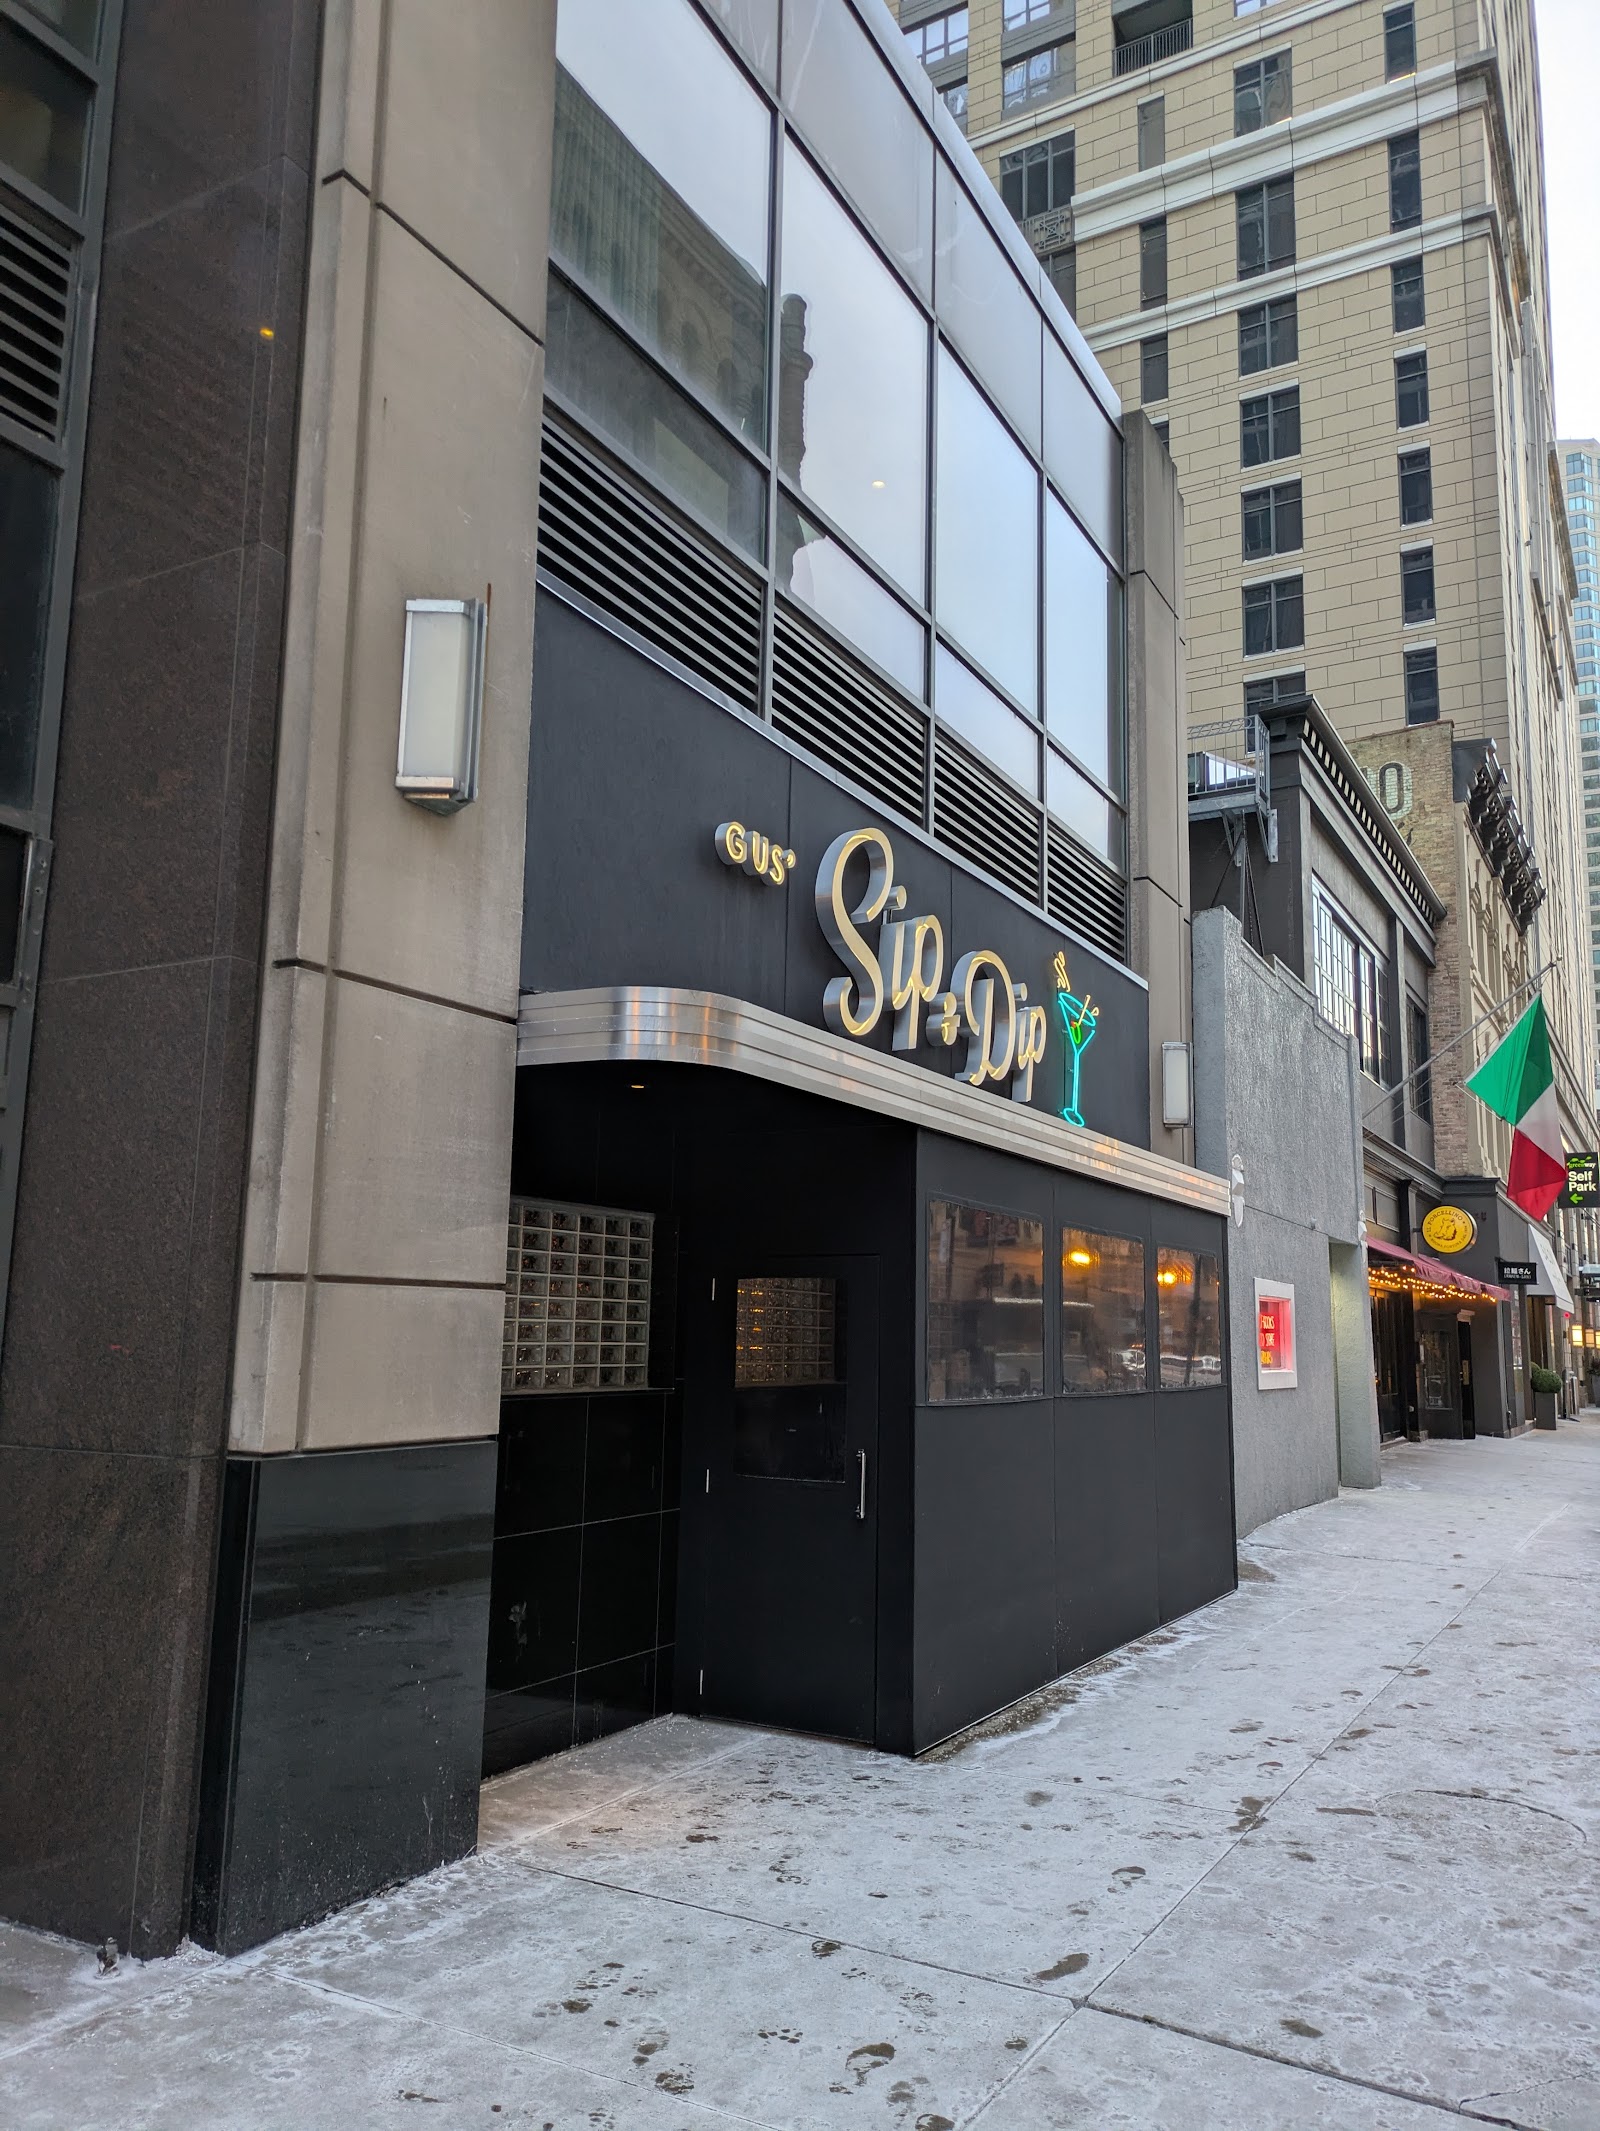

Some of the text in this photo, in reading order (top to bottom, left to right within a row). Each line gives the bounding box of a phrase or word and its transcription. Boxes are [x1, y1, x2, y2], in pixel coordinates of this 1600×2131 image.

[815, 827, 944, 1051] Sip
[950, 950, 1047, 1102] Dip
[1568, 1171, 1593, 1181] Self
[1568, 1182, 1597, 1191] Park
[1428, 1210, 1463, 1225] PORCELLINO
